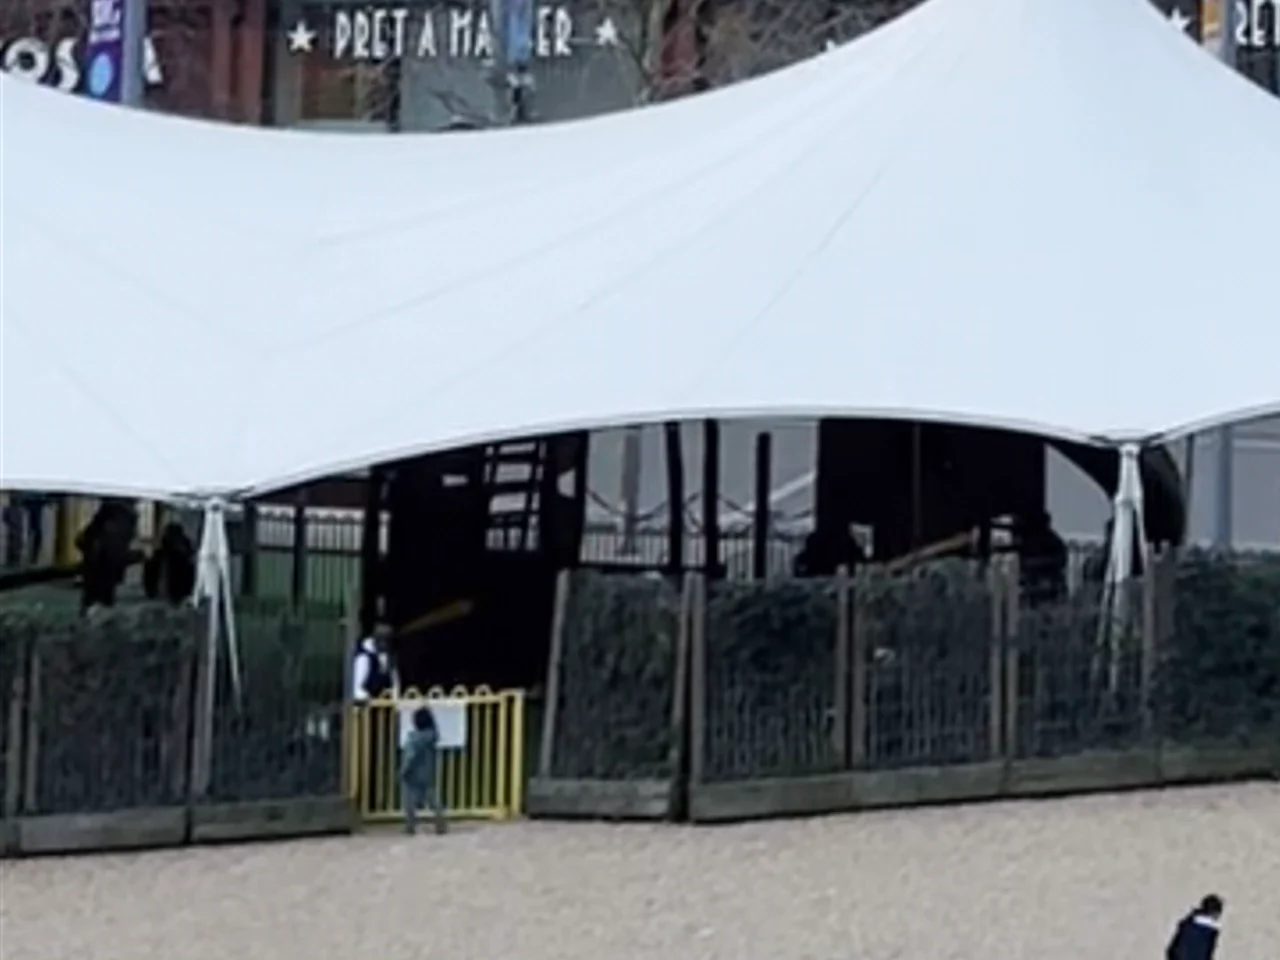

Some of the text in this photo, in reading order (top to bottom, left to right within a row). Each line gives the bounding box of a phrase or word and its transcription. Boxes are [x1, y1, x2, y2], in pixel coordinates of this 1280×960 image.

[334, 8, 572, 59] PRET A MAER
